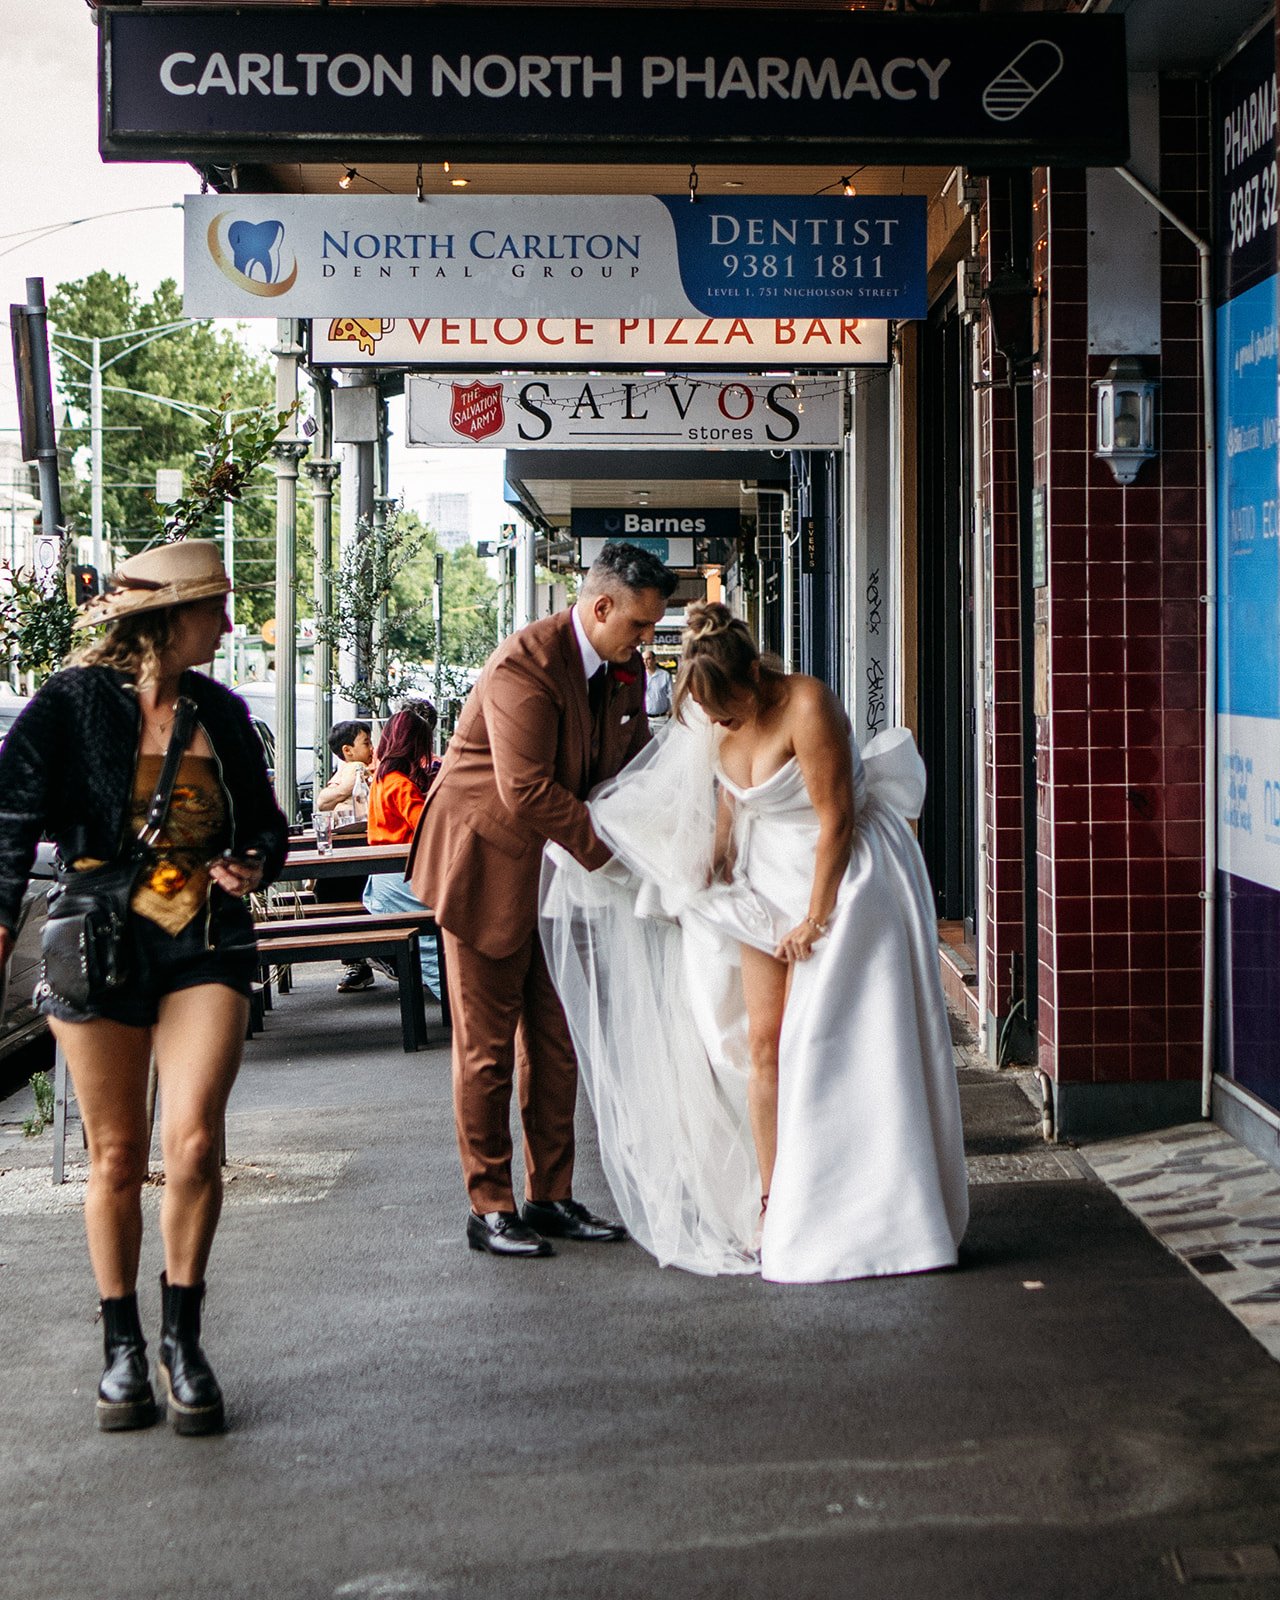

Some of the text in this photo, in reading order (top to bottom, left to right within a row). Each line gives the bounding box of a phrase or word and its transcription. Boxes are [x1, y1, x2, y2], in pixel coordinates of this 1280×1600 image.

[159, 51, 952, 101] CARLTON NORTH PHARMACY
[1224, 72, 1278, 176] PHARMA
[1230, 173, 1259, 253] 9387
[708, 214, 899, 245] DENTIST
[322, 229, 641, 259] NORTH CARLTON
[322, 264, 640, 279] DENTAL GROUP
[723, 254, 884, 279] 9381 1811
[759, 287, 778, 297] 751
[783, 287, 853, 297] NICHOLSON
[858, 287, 900, 298] STREET
[406, 318, 862, 345] VELOCE PIZZA BAR
[453, 390, 498, 426] SALVATION
[461, 387, 480, 406] THE
[470, 406, 497, 433] ARMY
[517, 381, 800, 442] SALVOS
[688, 425, 753, 441] stores
[624, 513, 706, 533] Barnes
